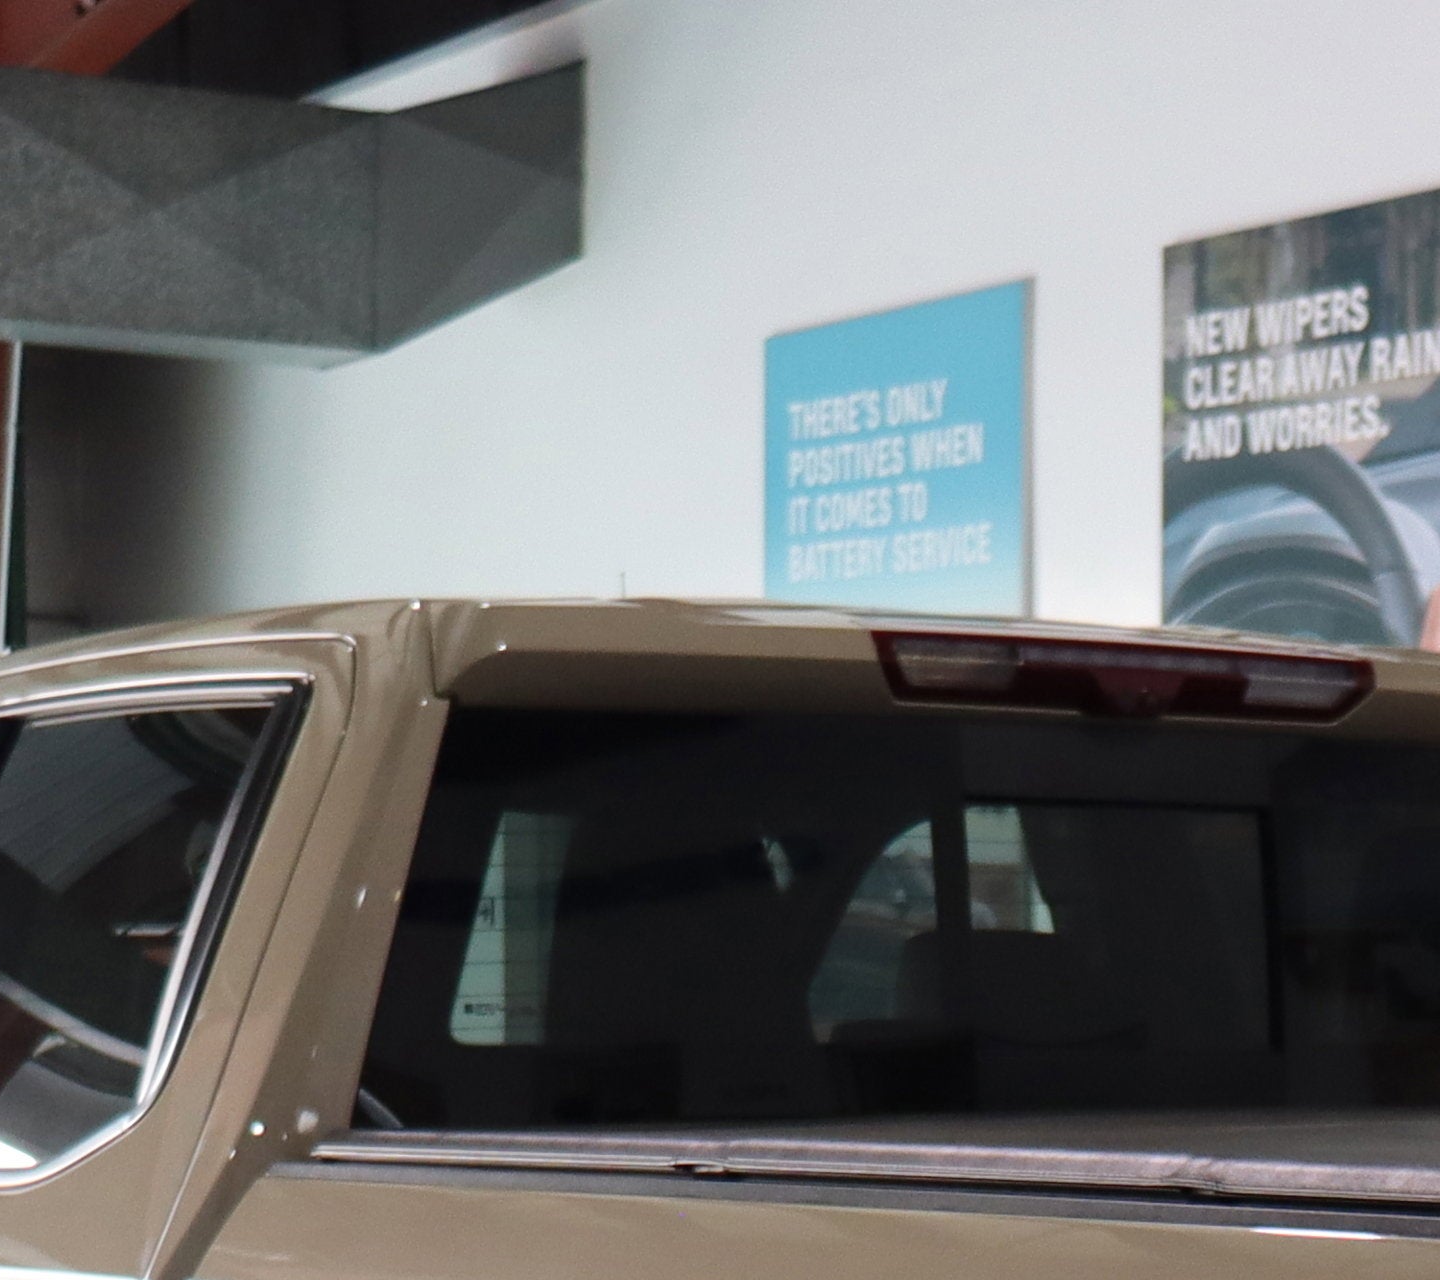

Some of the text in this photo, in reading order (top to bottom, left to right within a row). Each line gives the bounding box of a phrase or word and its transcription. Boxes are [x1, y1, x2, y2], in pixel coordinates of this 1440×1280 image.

[1184, 286, 1369, 358] NEW WIPERS
[1183, 355, 1274, 411] CLEAR
[1281, 343, 1365, 395] AWAY
[789, 379, 948, 439] THERE'S ONLY
[1183, 394, 1391, 463] AND WORRIES.
[789, 424, 984, 487] POSITIVES WHEN
[789, 482, 927, 535] IT COMES TO
[789, 522, 992, 583] BATTERY SERVICE
